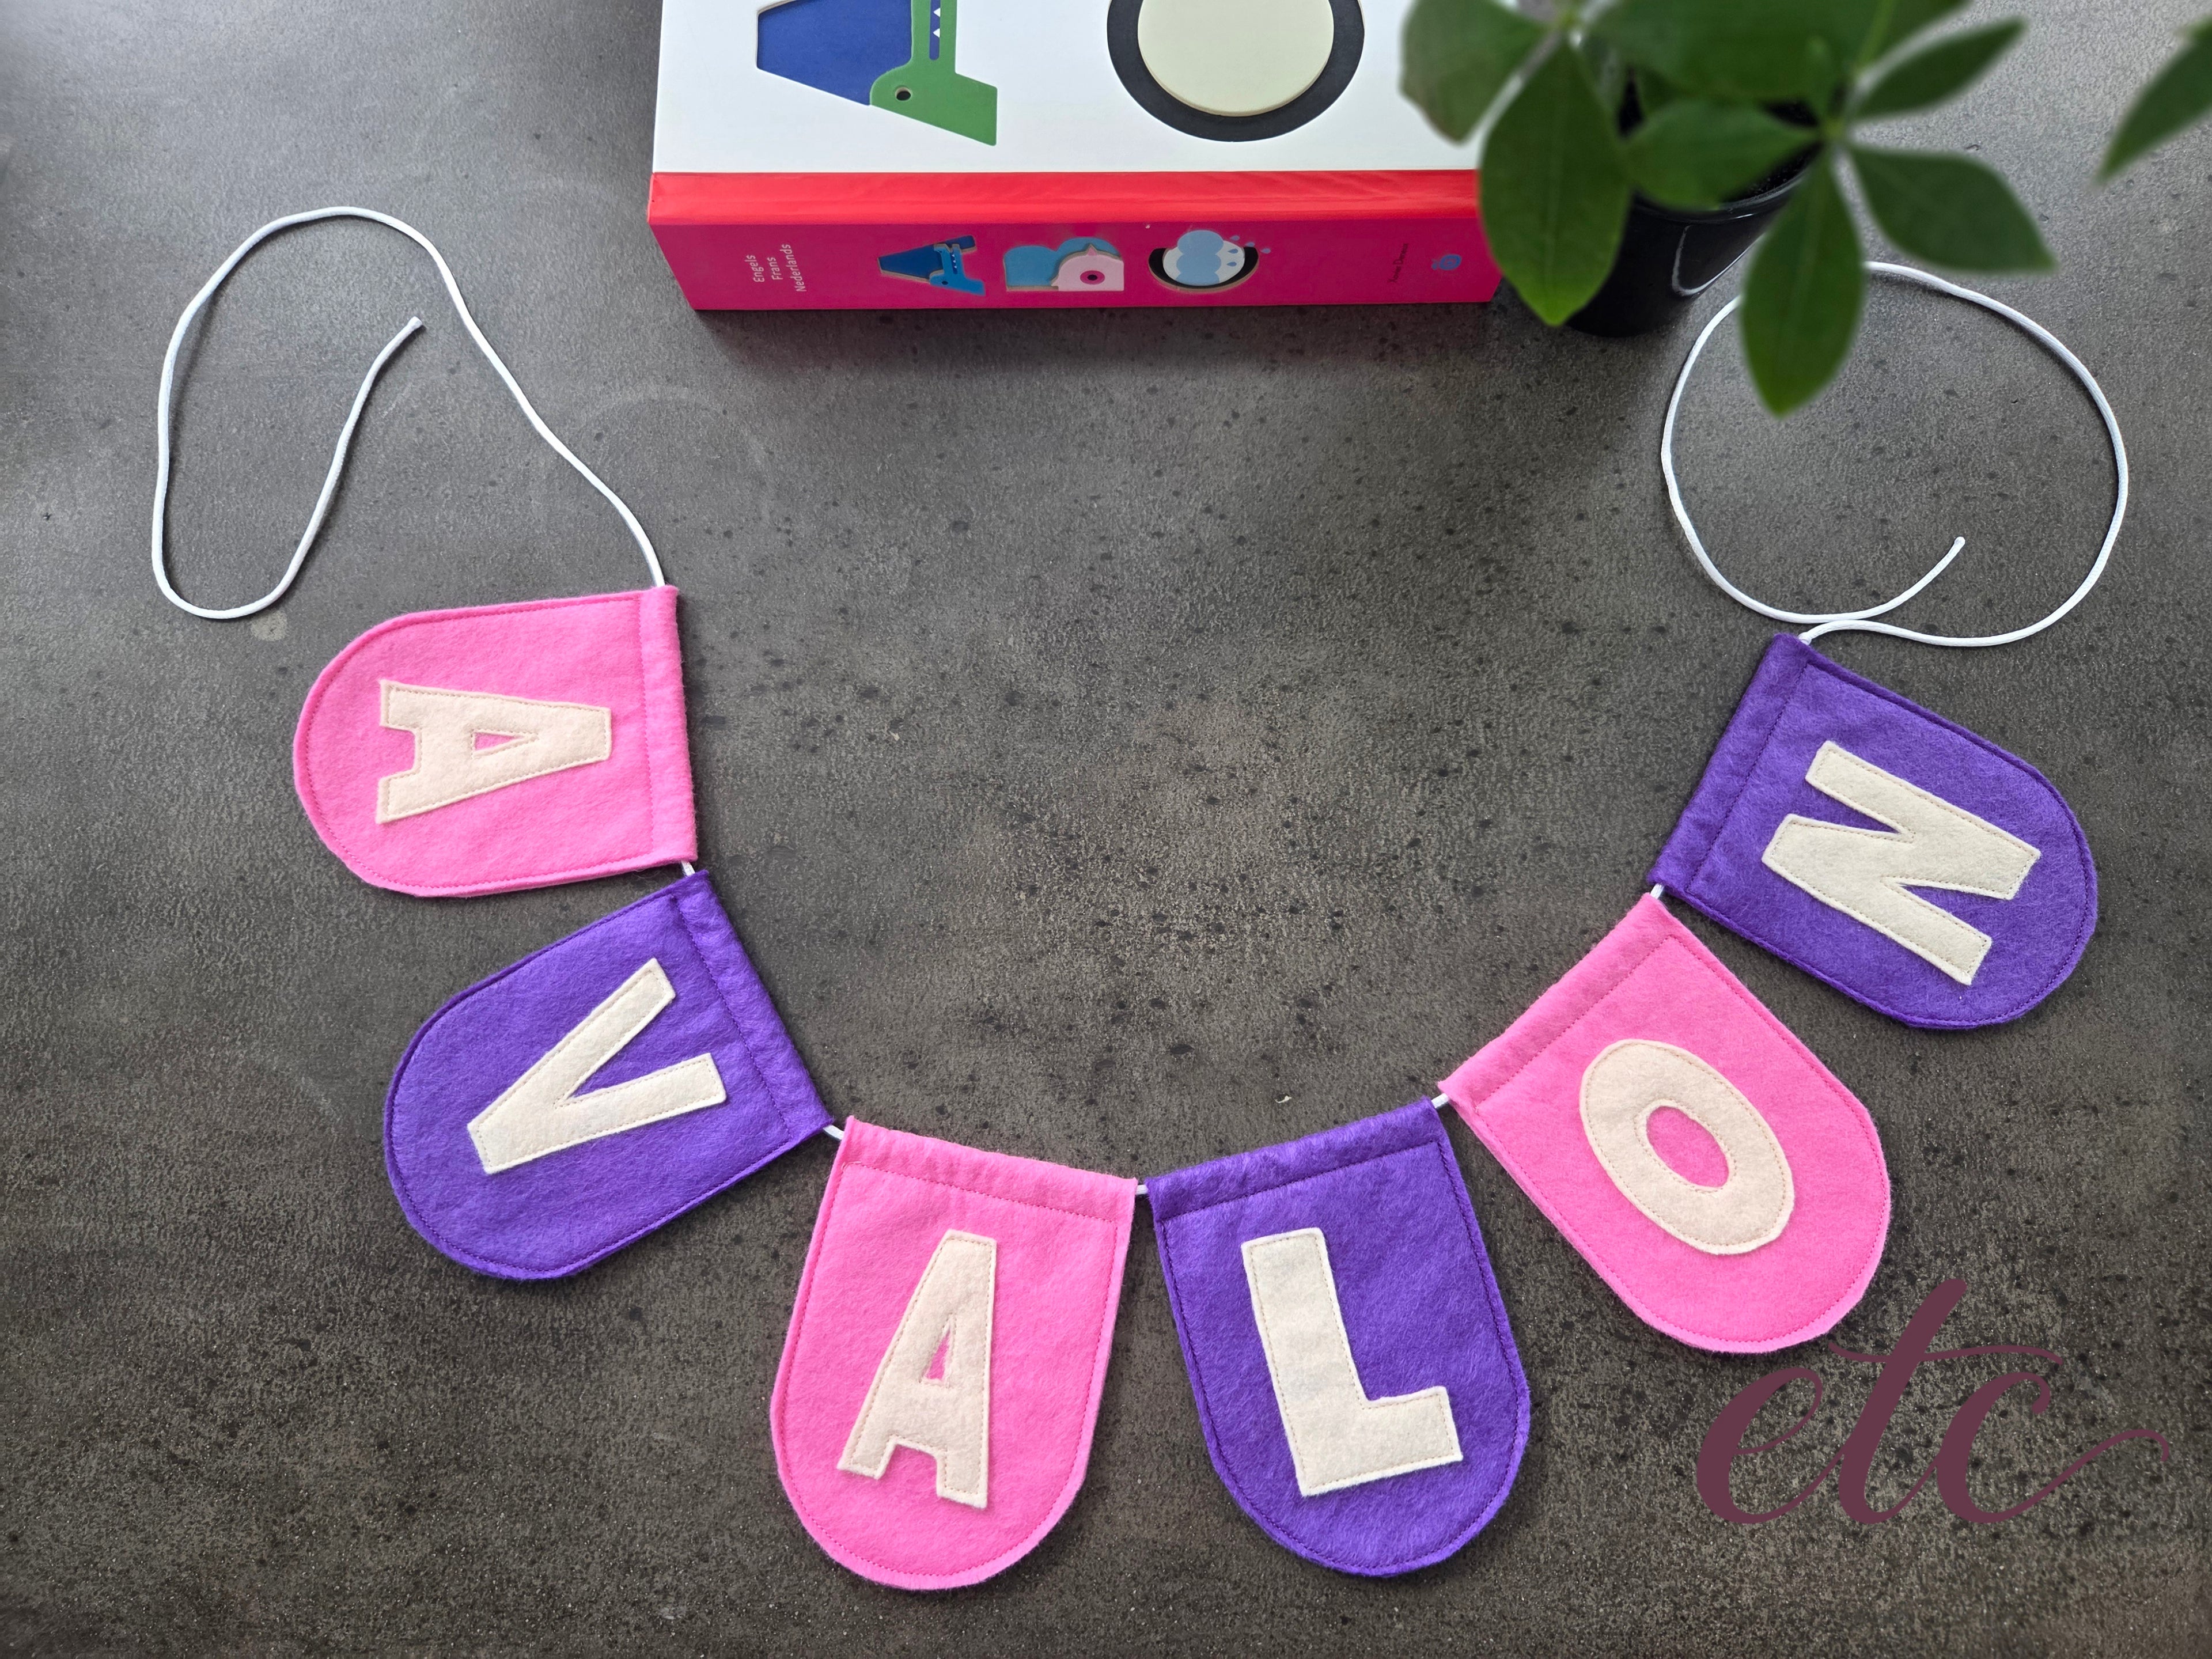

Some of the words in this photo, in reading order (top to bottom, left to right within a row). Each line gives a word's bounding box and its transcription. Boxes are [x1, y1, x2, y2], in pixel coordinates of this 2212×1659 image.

[744, 255, 765, 282] Engels
[767, 257, 783, 281] Frans
[779, 244, 807, 292] Nederlands
